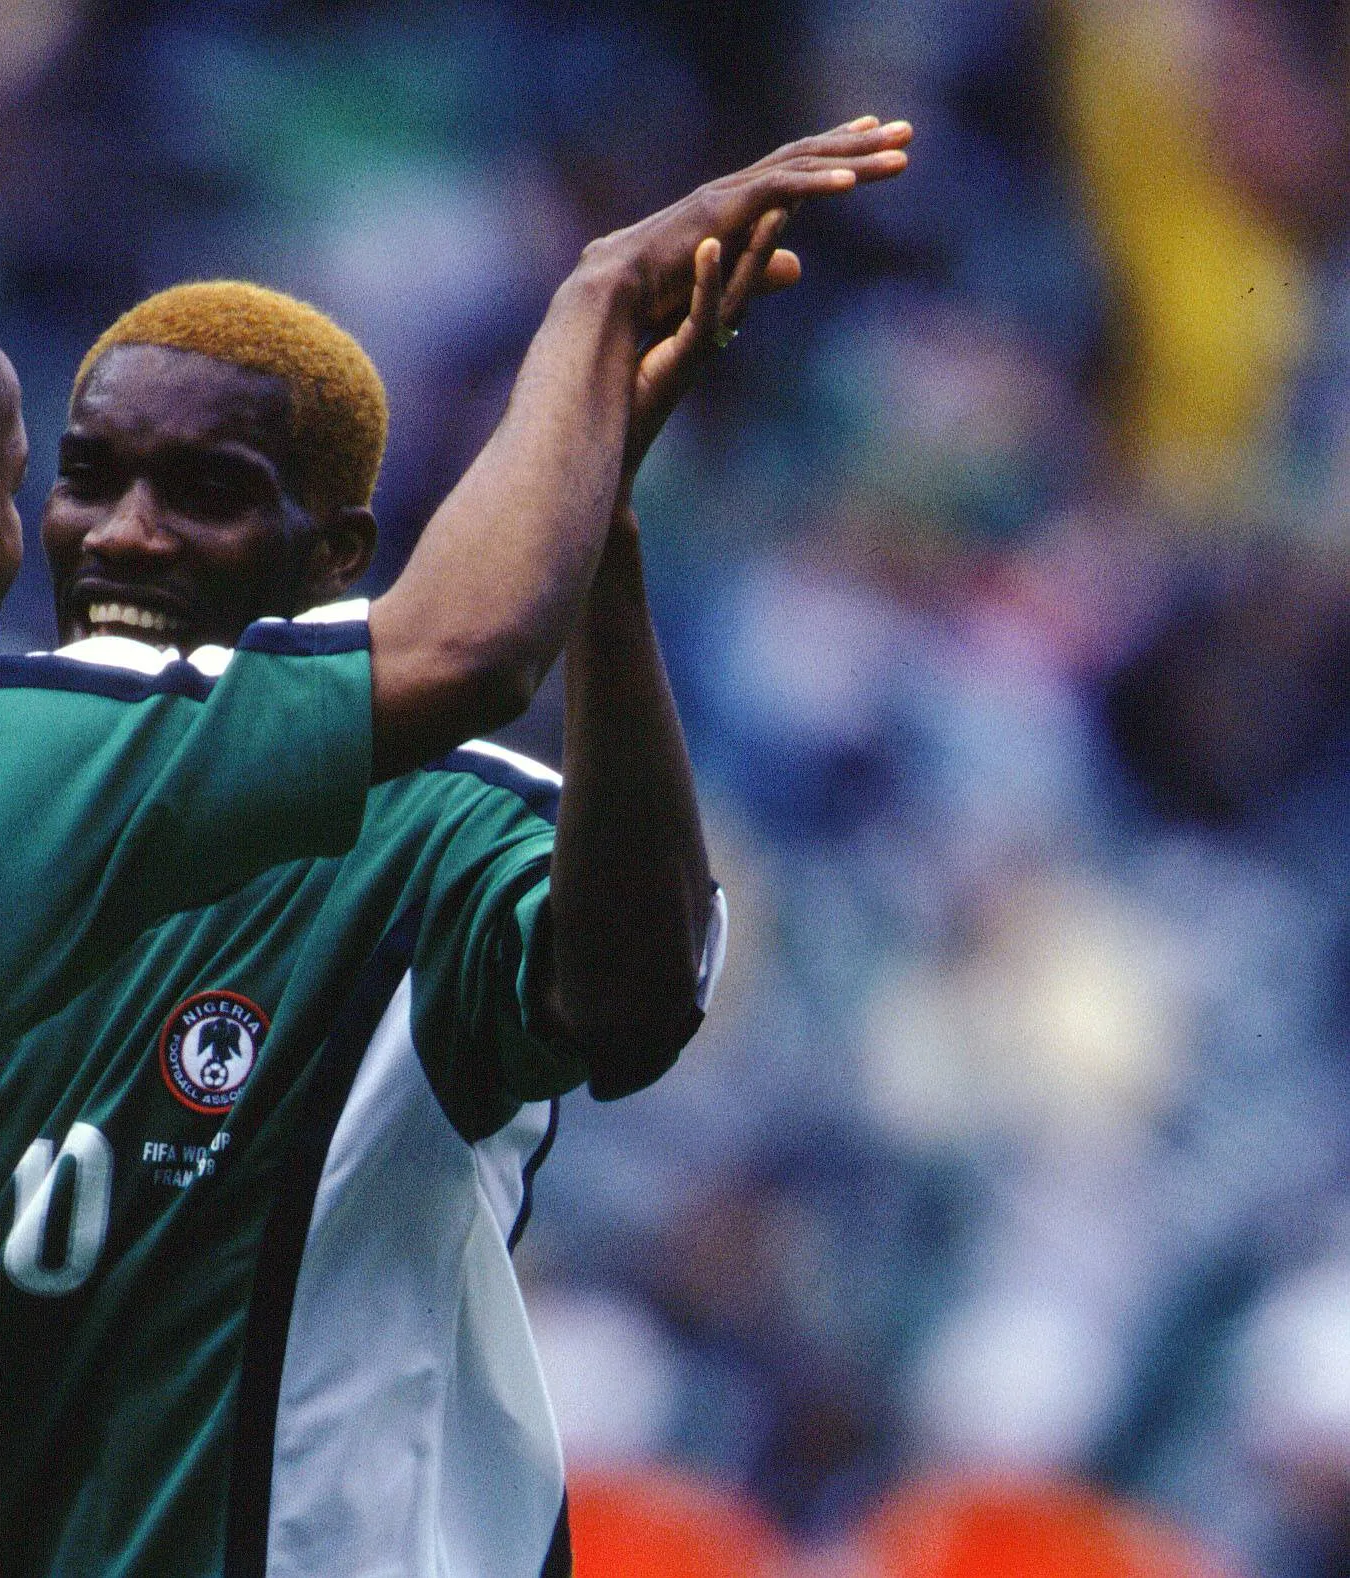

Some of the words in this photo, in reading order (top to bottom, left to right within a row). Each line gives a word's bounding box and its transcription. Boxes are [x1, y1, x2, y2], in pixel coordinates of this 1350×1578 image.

[182, 1001, 260, 1035] NIGERIA
[169, 1034, 200, 1099] FOOTBALL
[143, 1141, 176, 1162] FIFA
